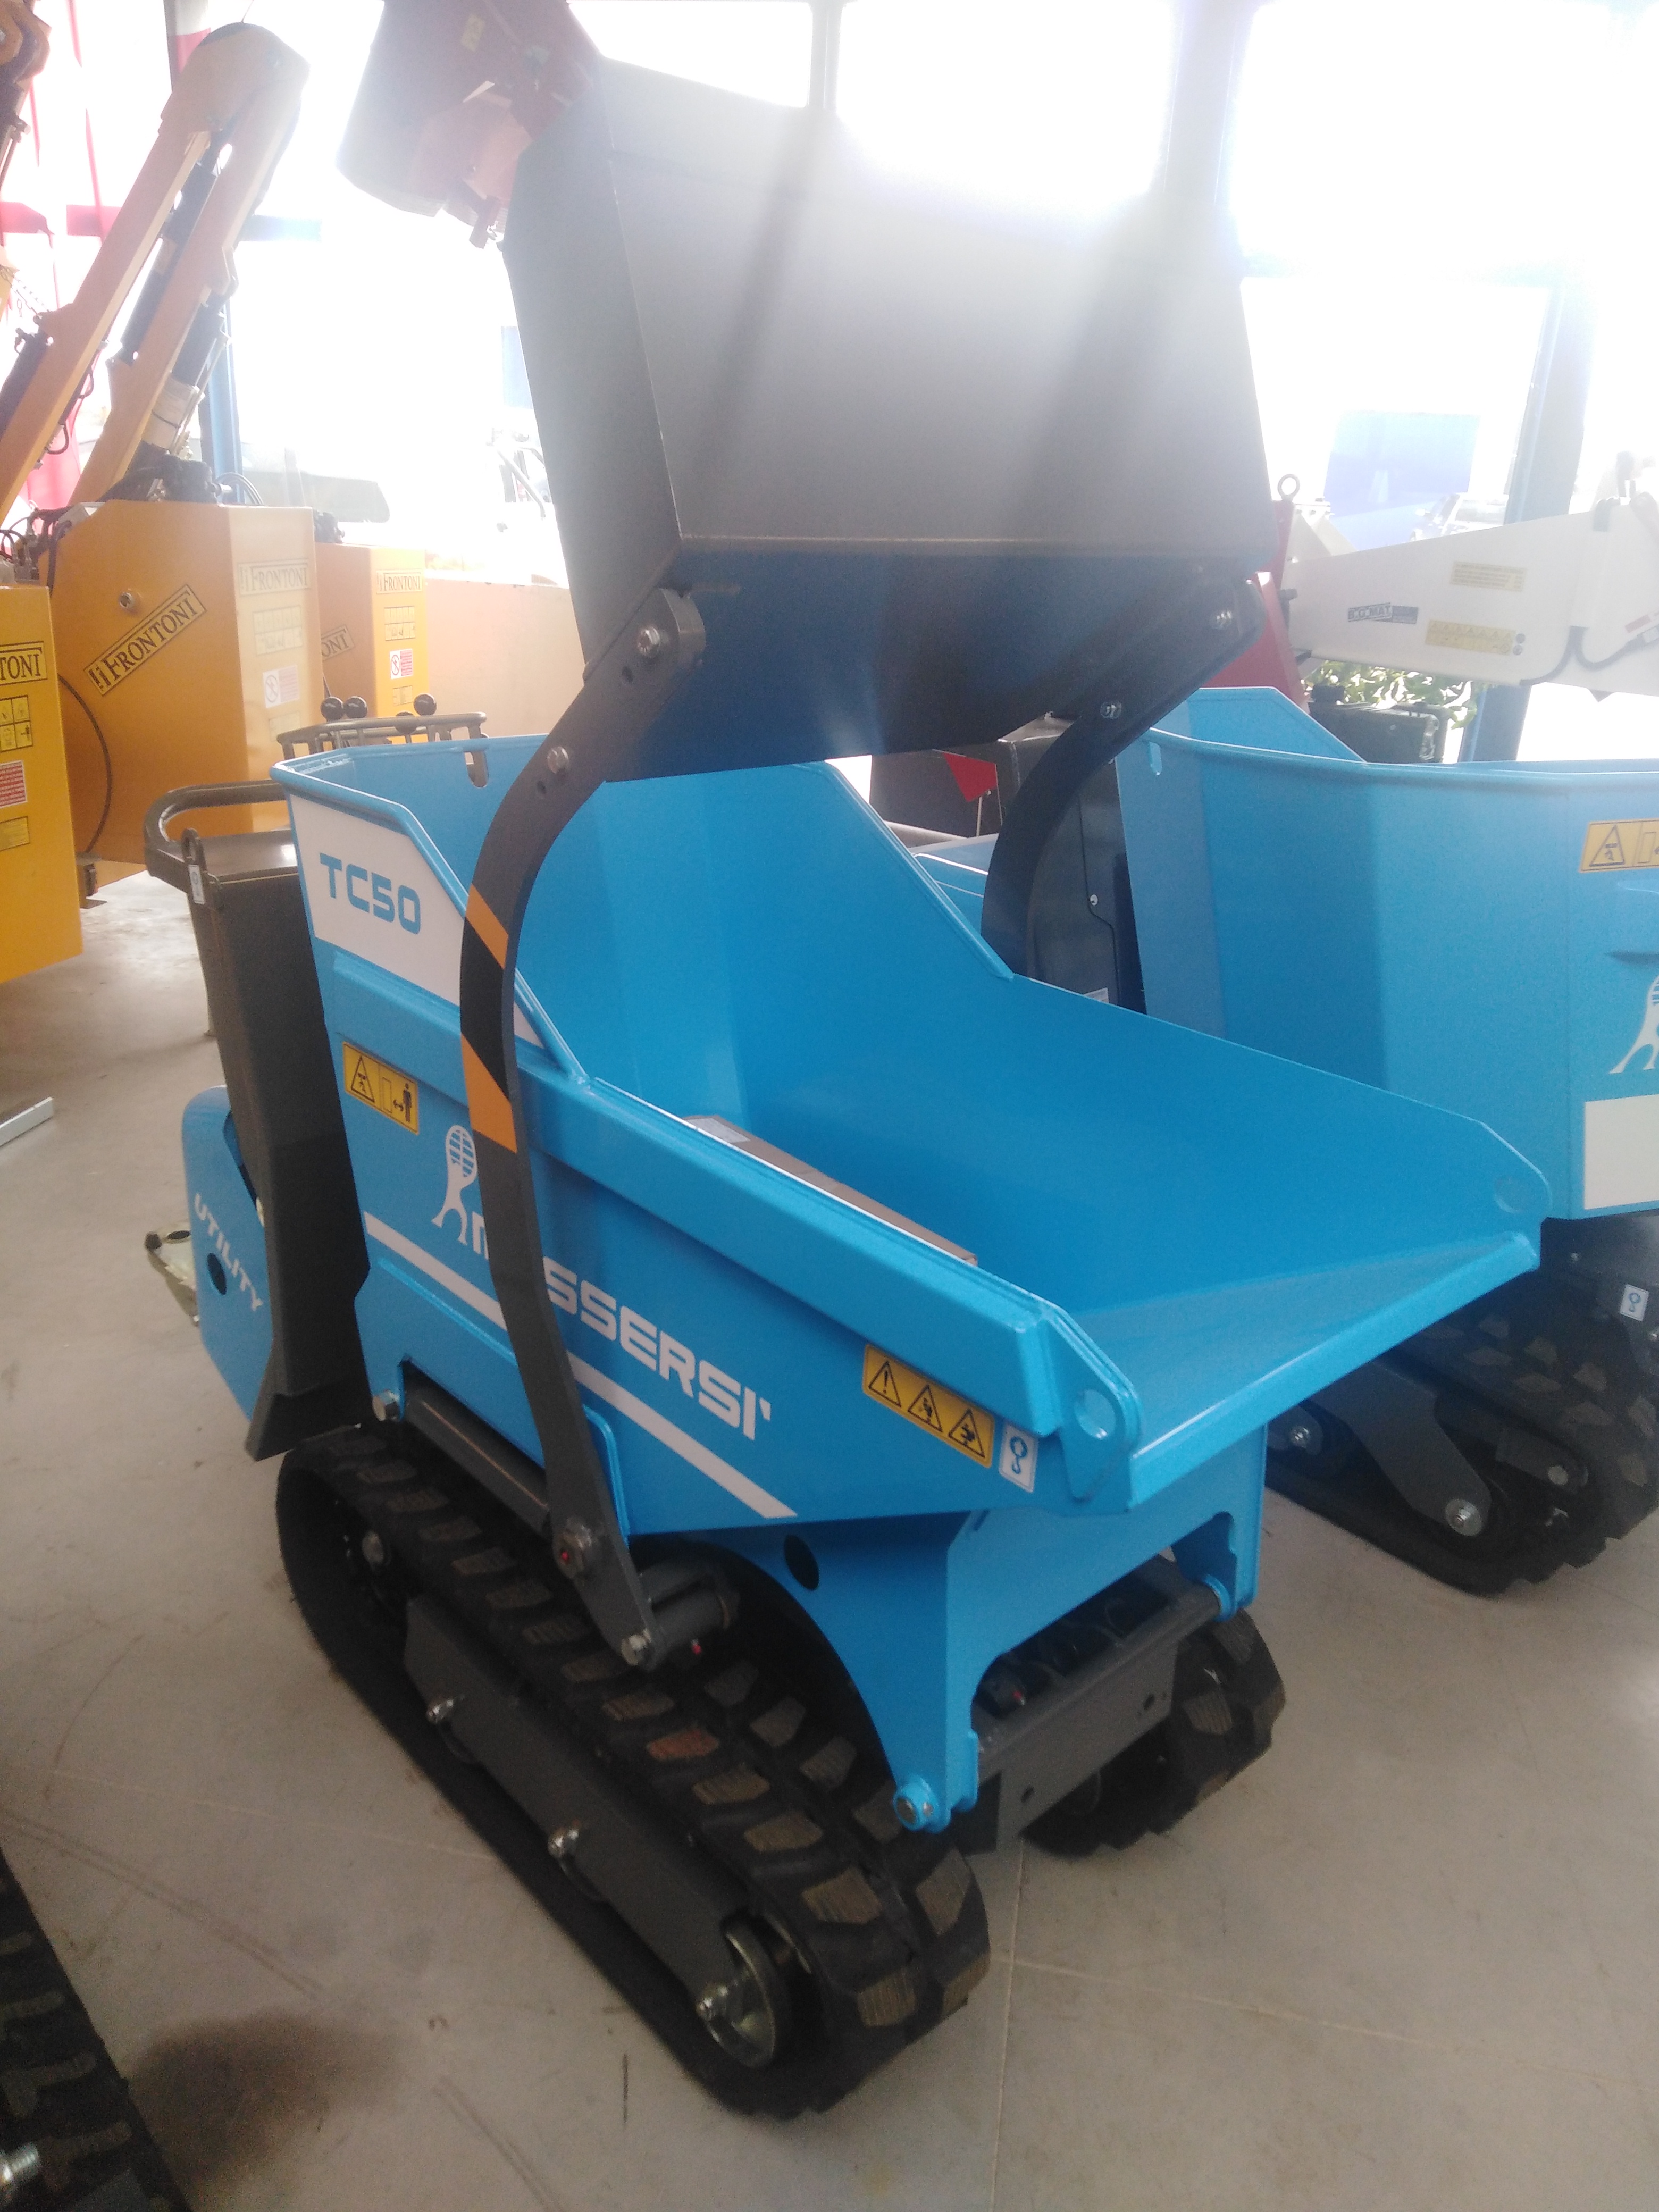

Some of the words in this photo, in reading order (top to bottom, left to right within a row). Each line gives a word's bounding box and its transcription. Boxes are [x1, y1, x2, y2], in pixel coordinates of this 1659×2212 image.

[250, 563, 308, 591] FRONTONI
[383, 572, 421, 591] FRONTONI
[101, 591, 197, 681] FRONTONI
[320, 852, 421, 935] TC50
[194, 1193, 264, 1312] UTILITY
